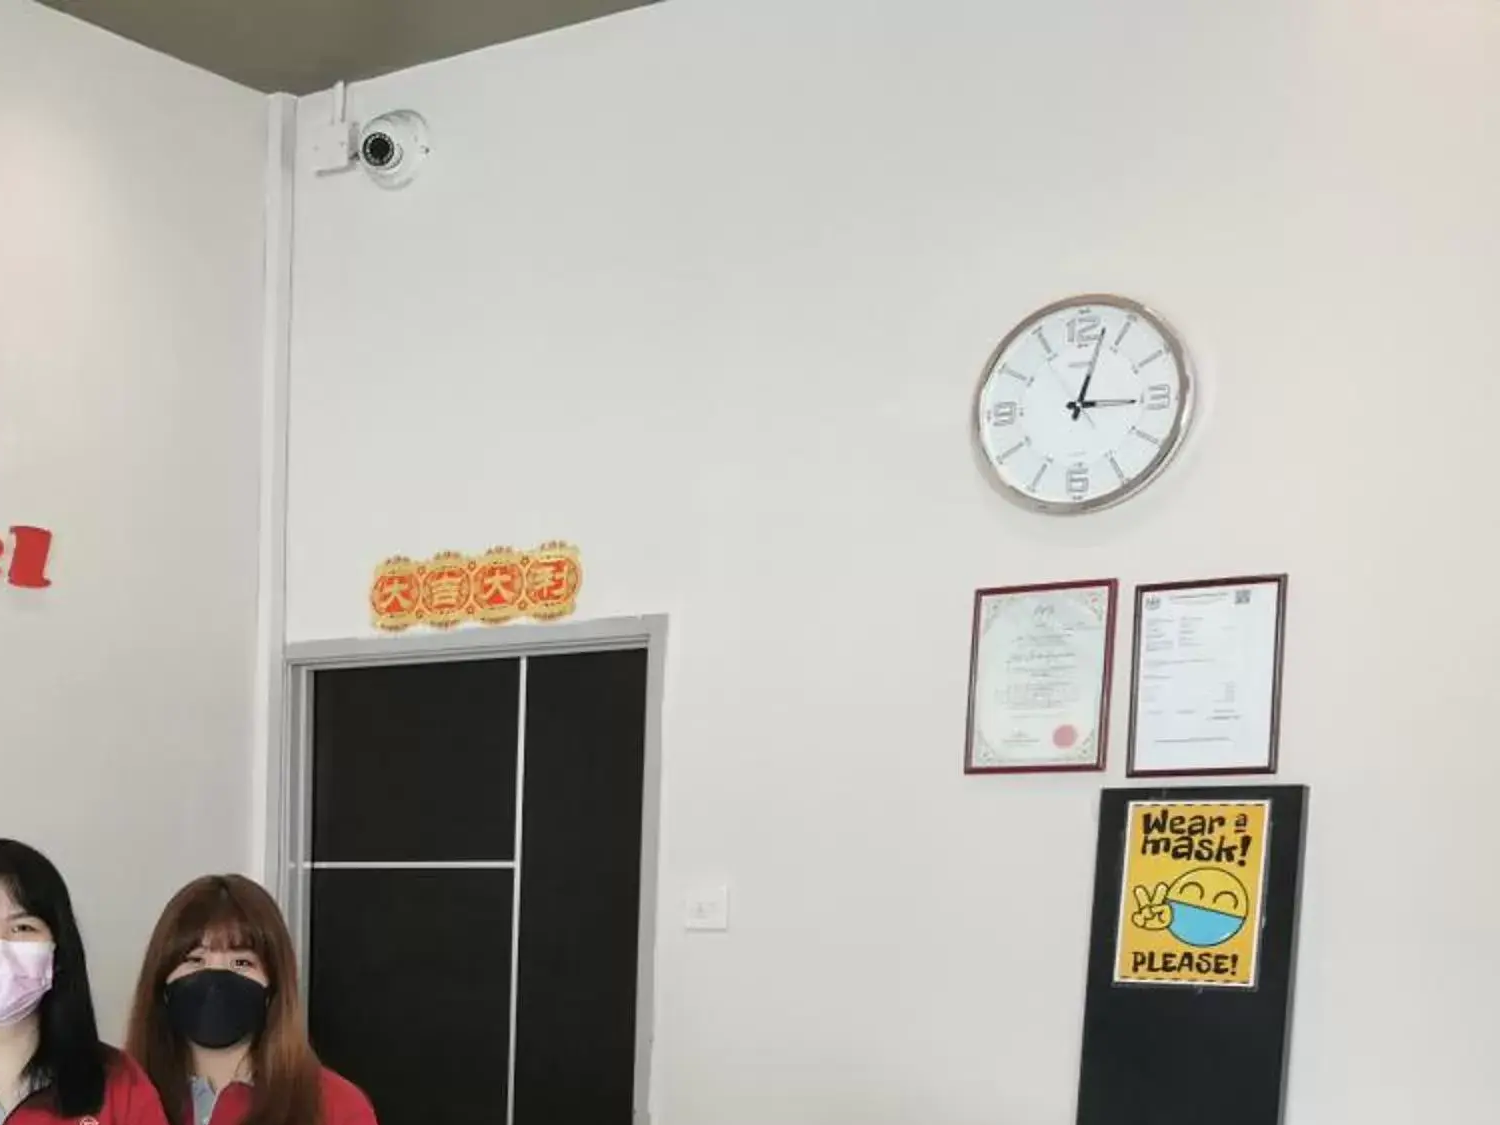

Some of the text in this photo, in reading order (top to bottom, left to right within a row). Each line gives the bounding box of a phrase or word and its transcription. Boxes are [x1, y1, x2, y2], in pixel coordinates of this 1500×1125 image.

[1066, 316, 1101, 343] 12
[1147, 384, 1170, 411] 3
[1066, 468, 1090, 494] 6
[1142, 808, 1248, 835] Wear a
[1141, 835, 1252, 867] mask!
[1131, 951, 1239, 976] PLEASE!
